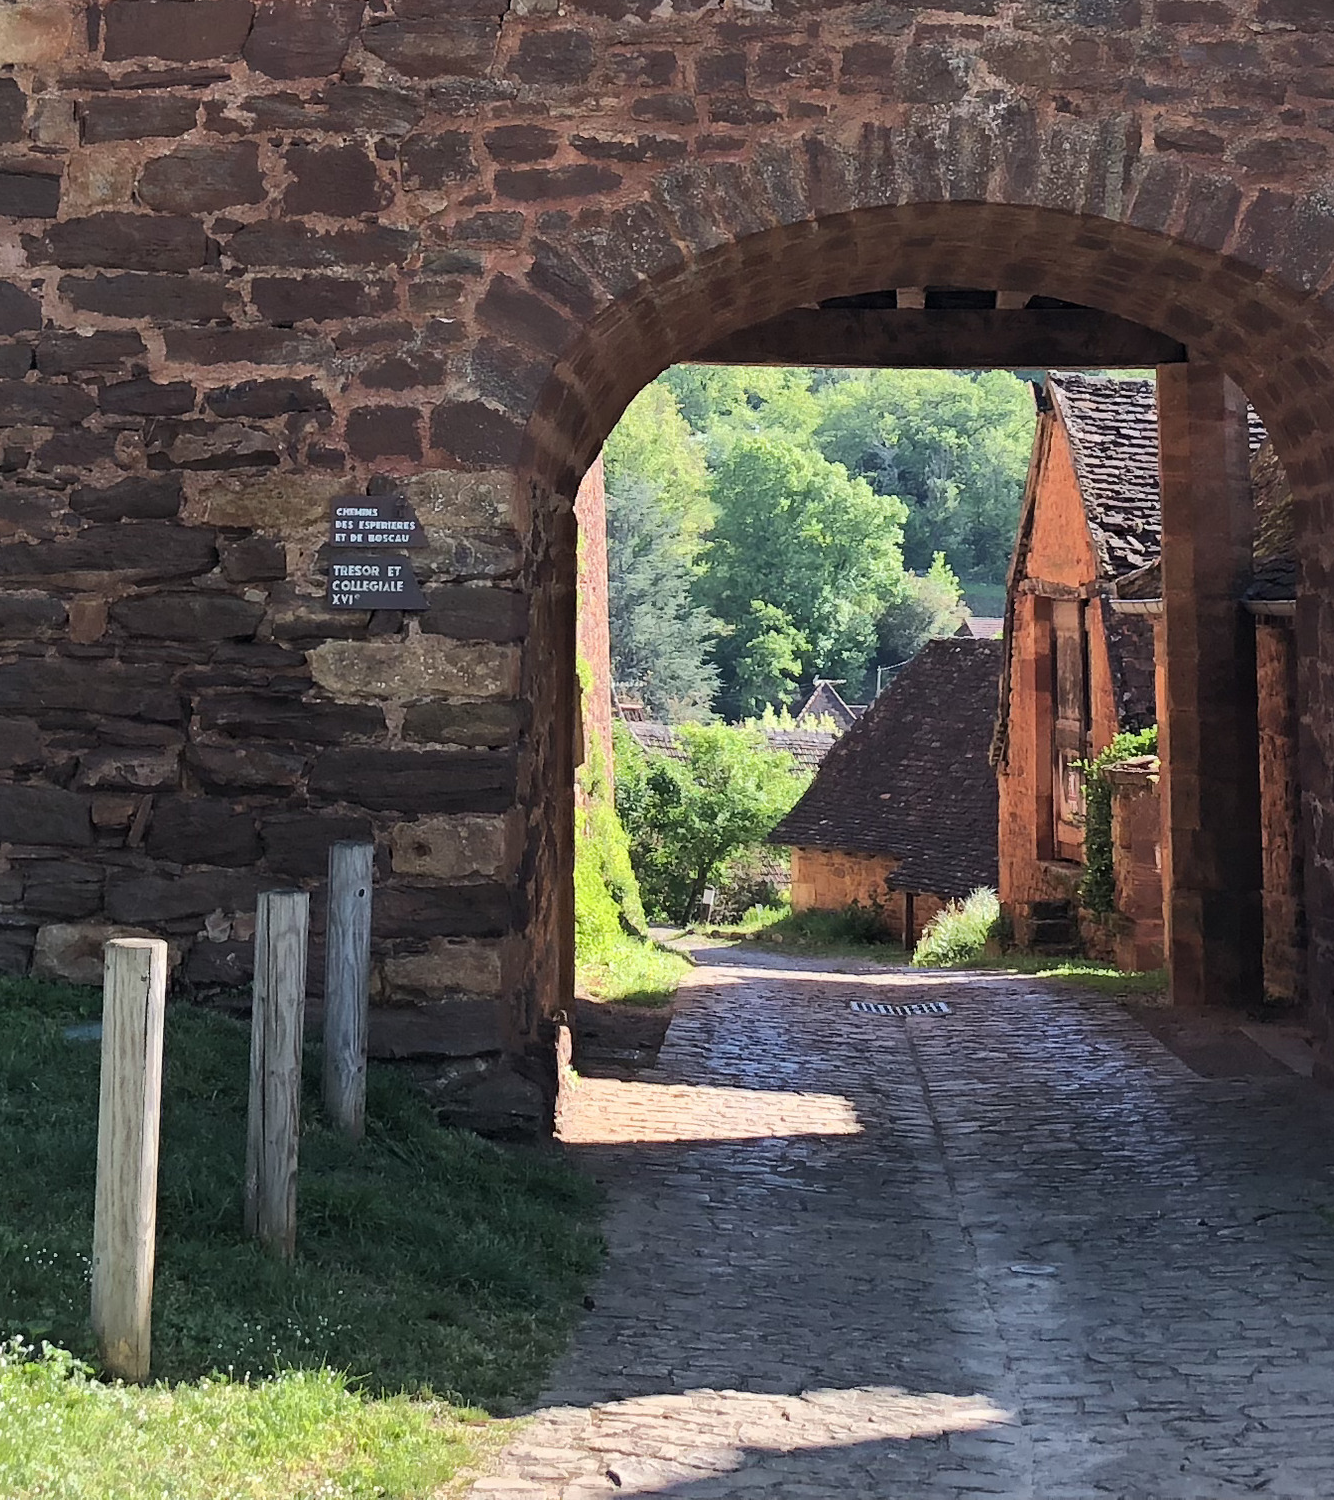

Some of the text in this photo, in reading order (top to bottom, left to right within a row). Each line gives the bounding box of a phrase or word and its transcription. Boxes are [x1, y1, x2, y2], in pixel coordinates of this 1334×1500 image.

[336, 507, 378, 517] CHEMINS
[335, 520, 354, 530] DES
[335, 533, 346, 542] ET
[350, 533, 363, 542] DE
[333, 565, 402, 577] TRESOR ET
[332, 580, 404, 592] COLLEGIALE
